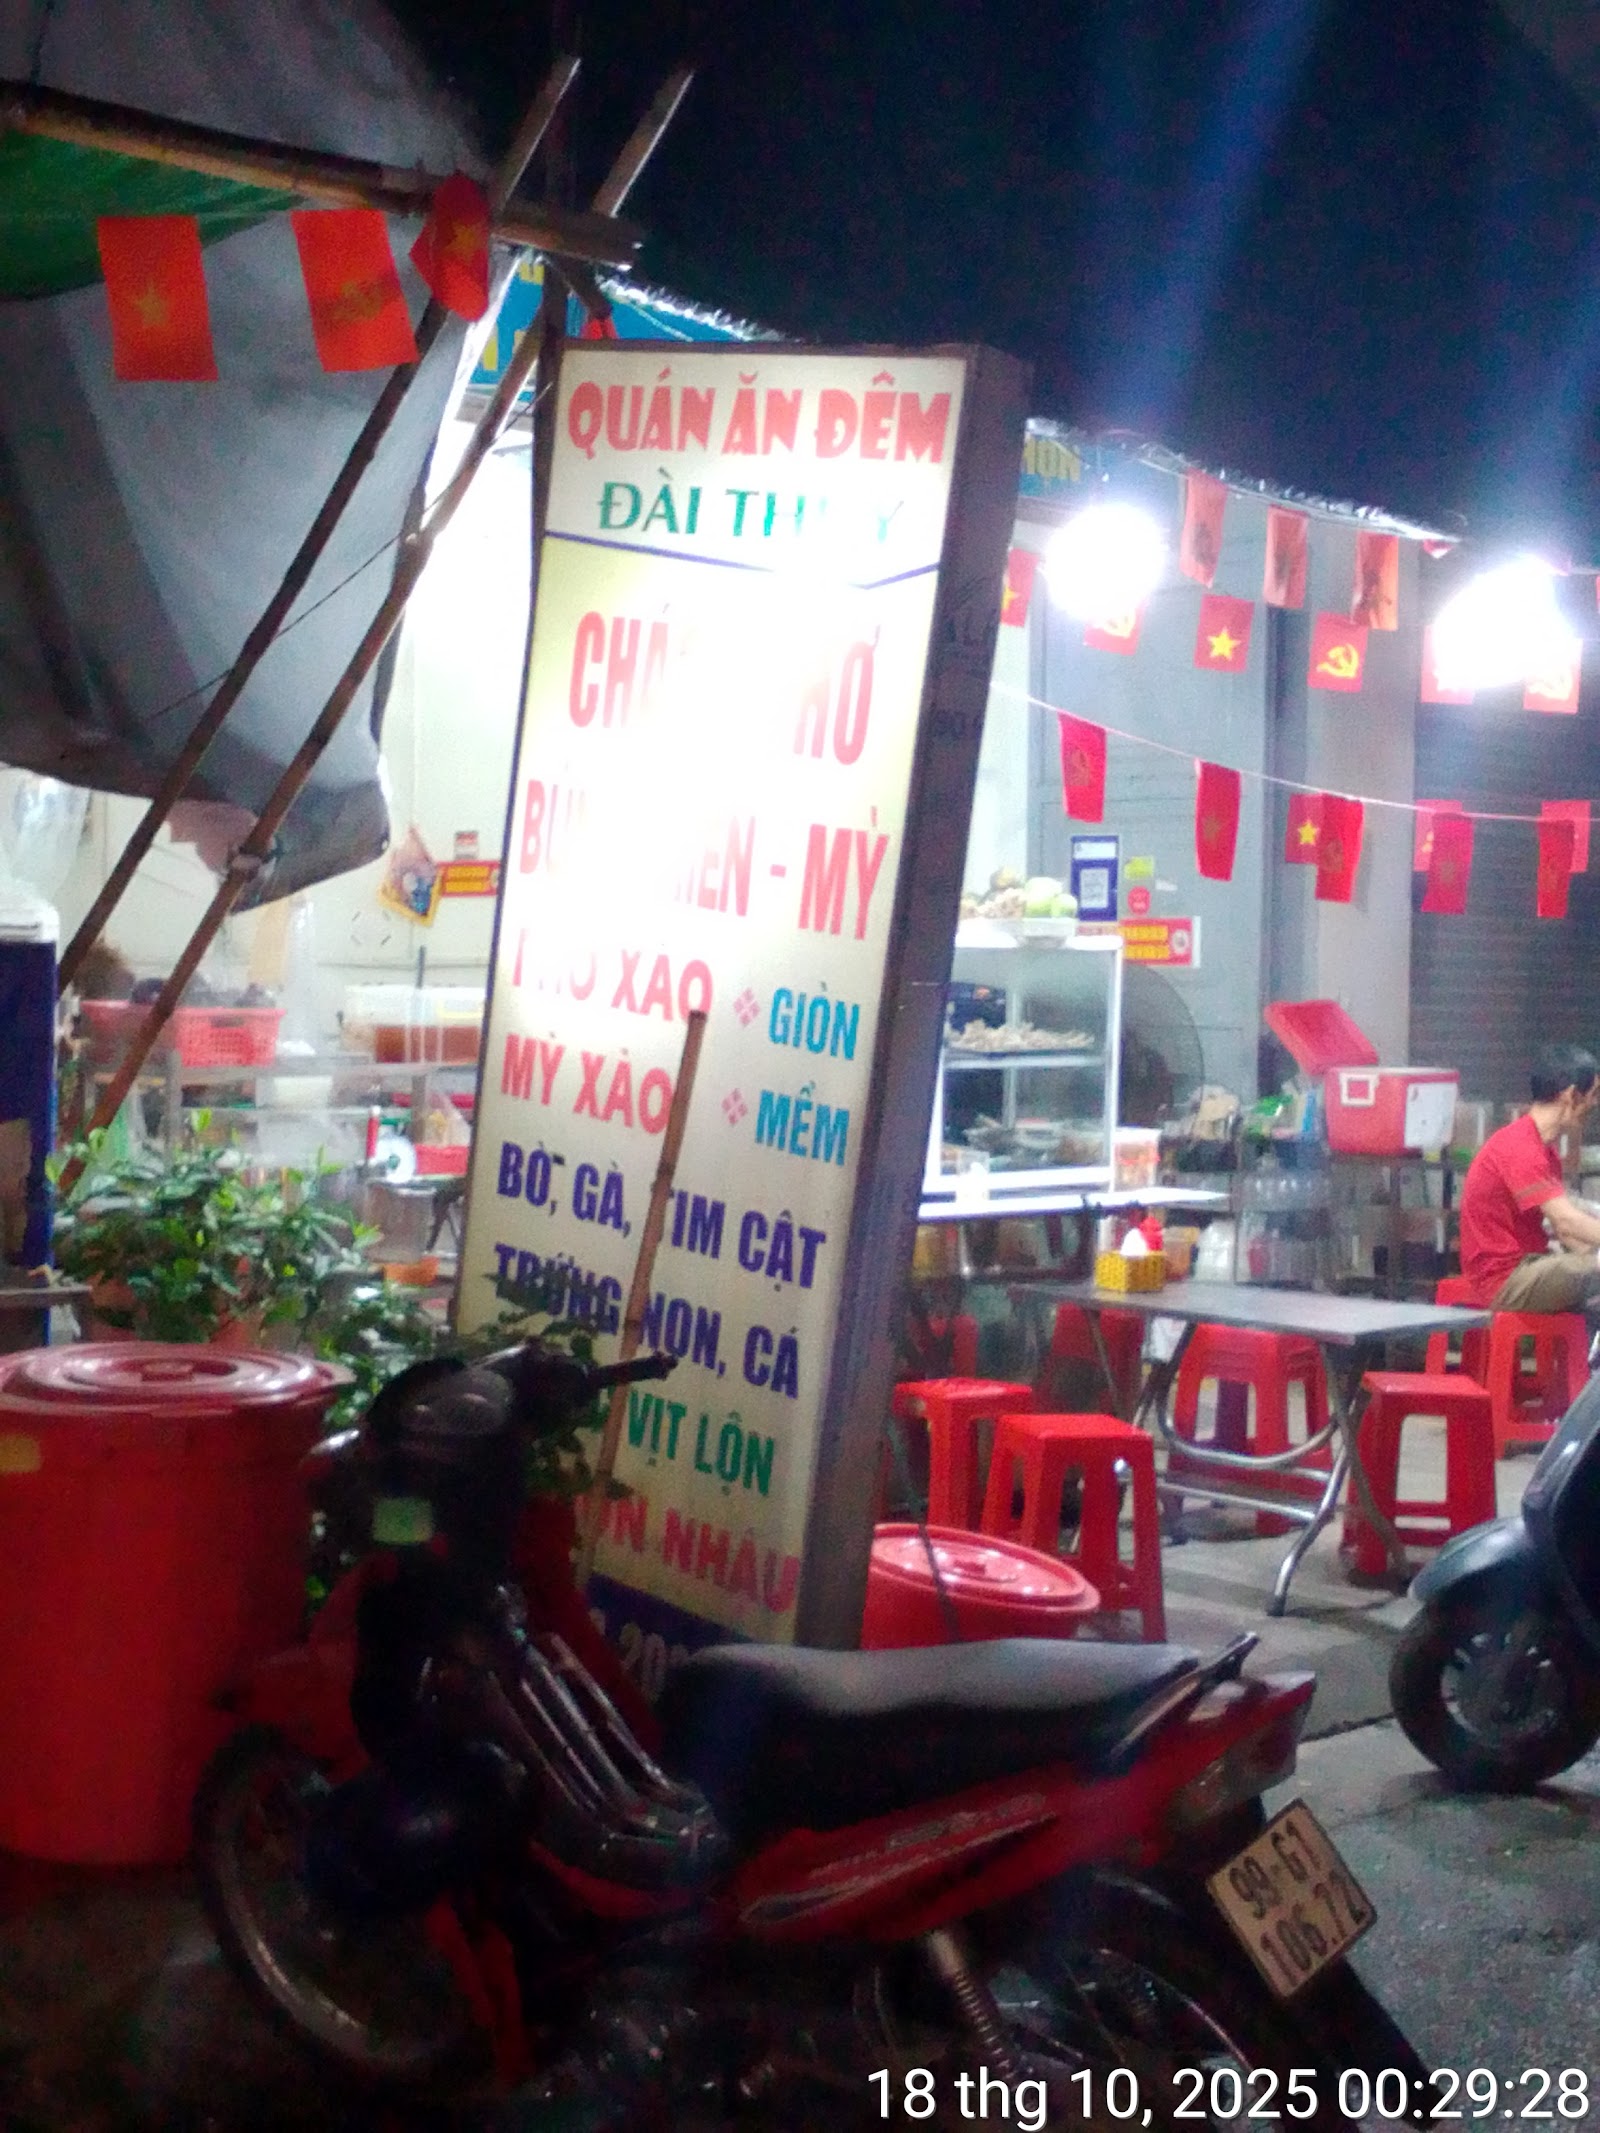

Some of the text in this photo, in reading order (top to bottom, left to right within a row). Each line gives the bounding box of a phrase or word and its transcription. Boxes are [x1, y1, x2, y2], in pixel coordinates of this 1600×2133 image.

[567, 366, 952, 464] QUÁN ĂN ĐÊM
[597, 466, 905, 544] ĐÀI THY
[569, 602, 692, 729] CHÁ
[797, 804, 890, 941] MỲ
[768, 980, 861, 1061] GIÒN
[500, 1030, 850, 1167] MỲ XÀO MỀM
[571, 1160, 632, 1239] GÀ,
[668, 1187, 727, 1261] IM
[737, 1208, 827, 1293] CẬT
[742, 1324, 800, 1401] CÁ
[627, 1389, 775, 1497] VỊT LỘN
